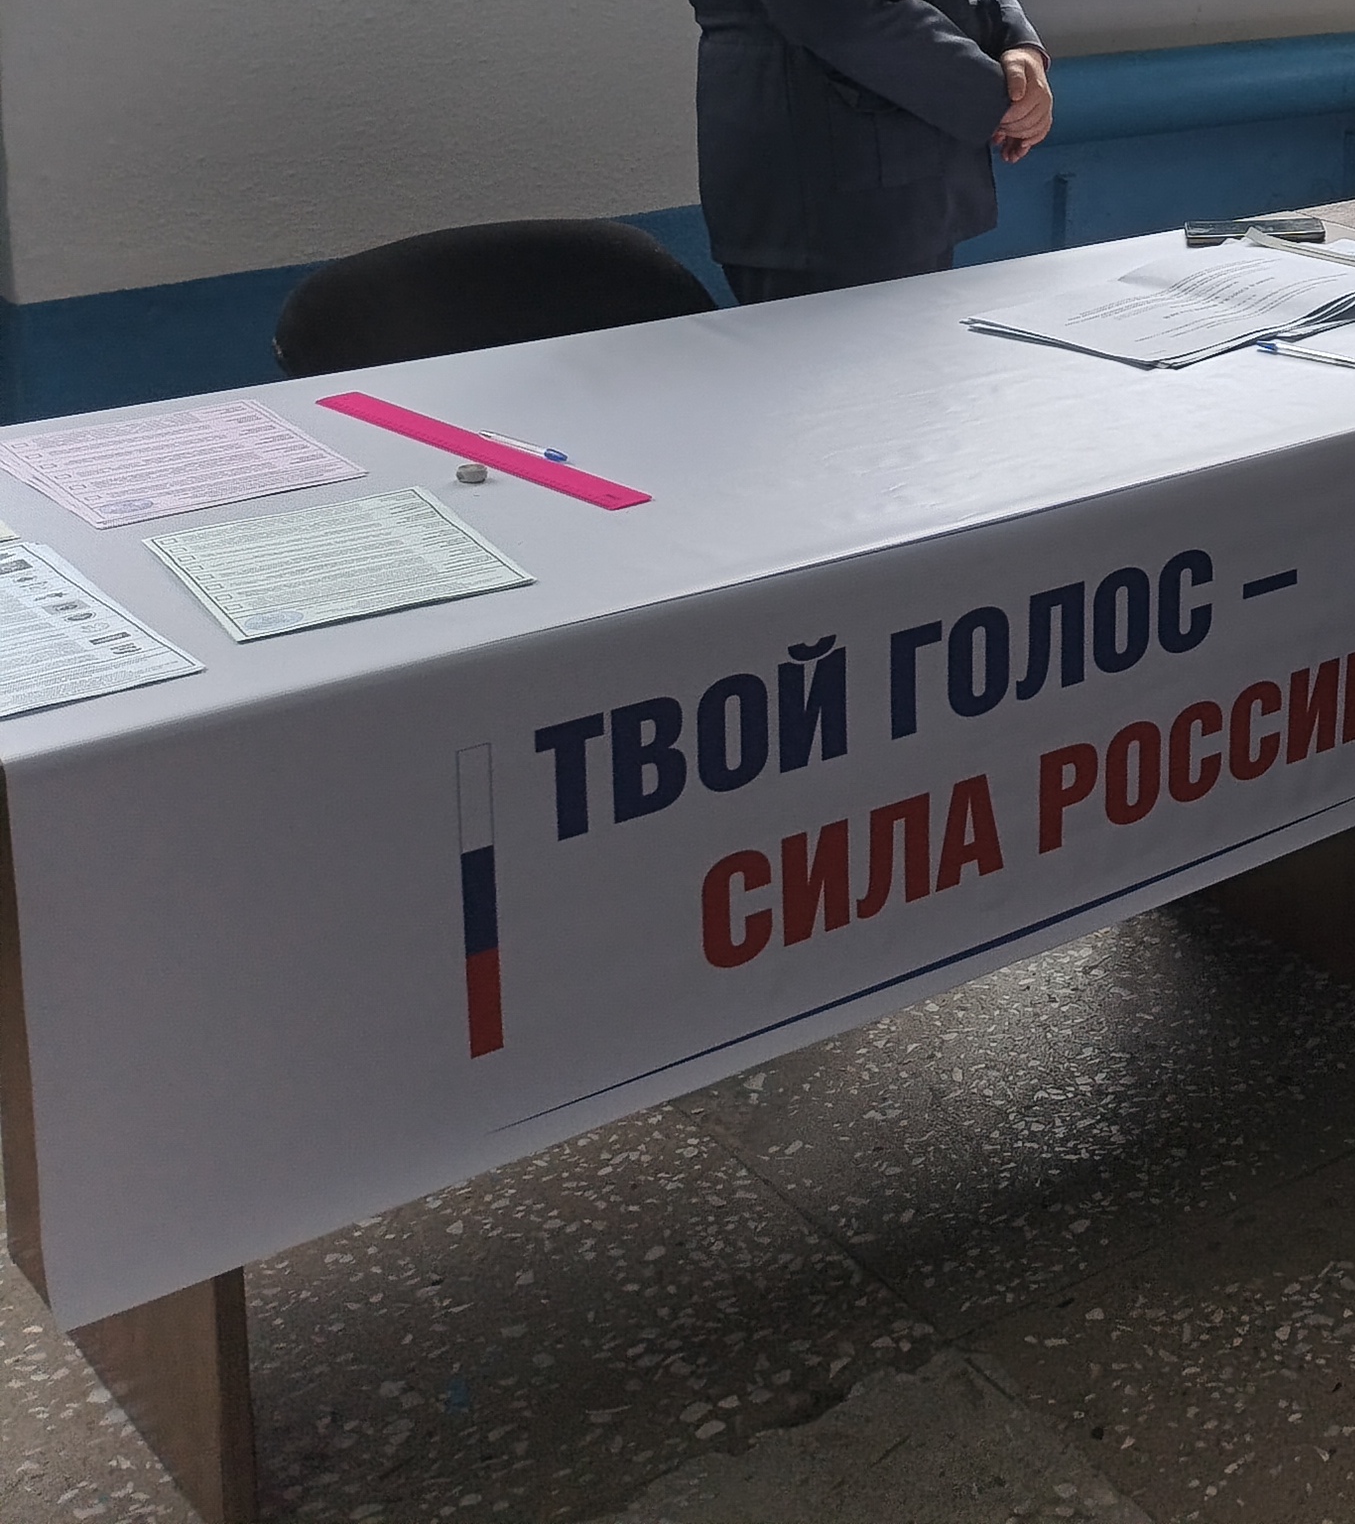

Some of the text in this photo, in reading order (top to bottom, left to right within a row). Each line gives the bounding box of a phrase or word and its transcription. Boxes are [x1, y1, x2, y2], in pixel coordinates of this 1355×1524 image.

[534, 633, 848, 842] ТВОЙ
[889, 548, 1213, 741] ГОЛОС
[700, 774, 1004, 969] СИЛА
